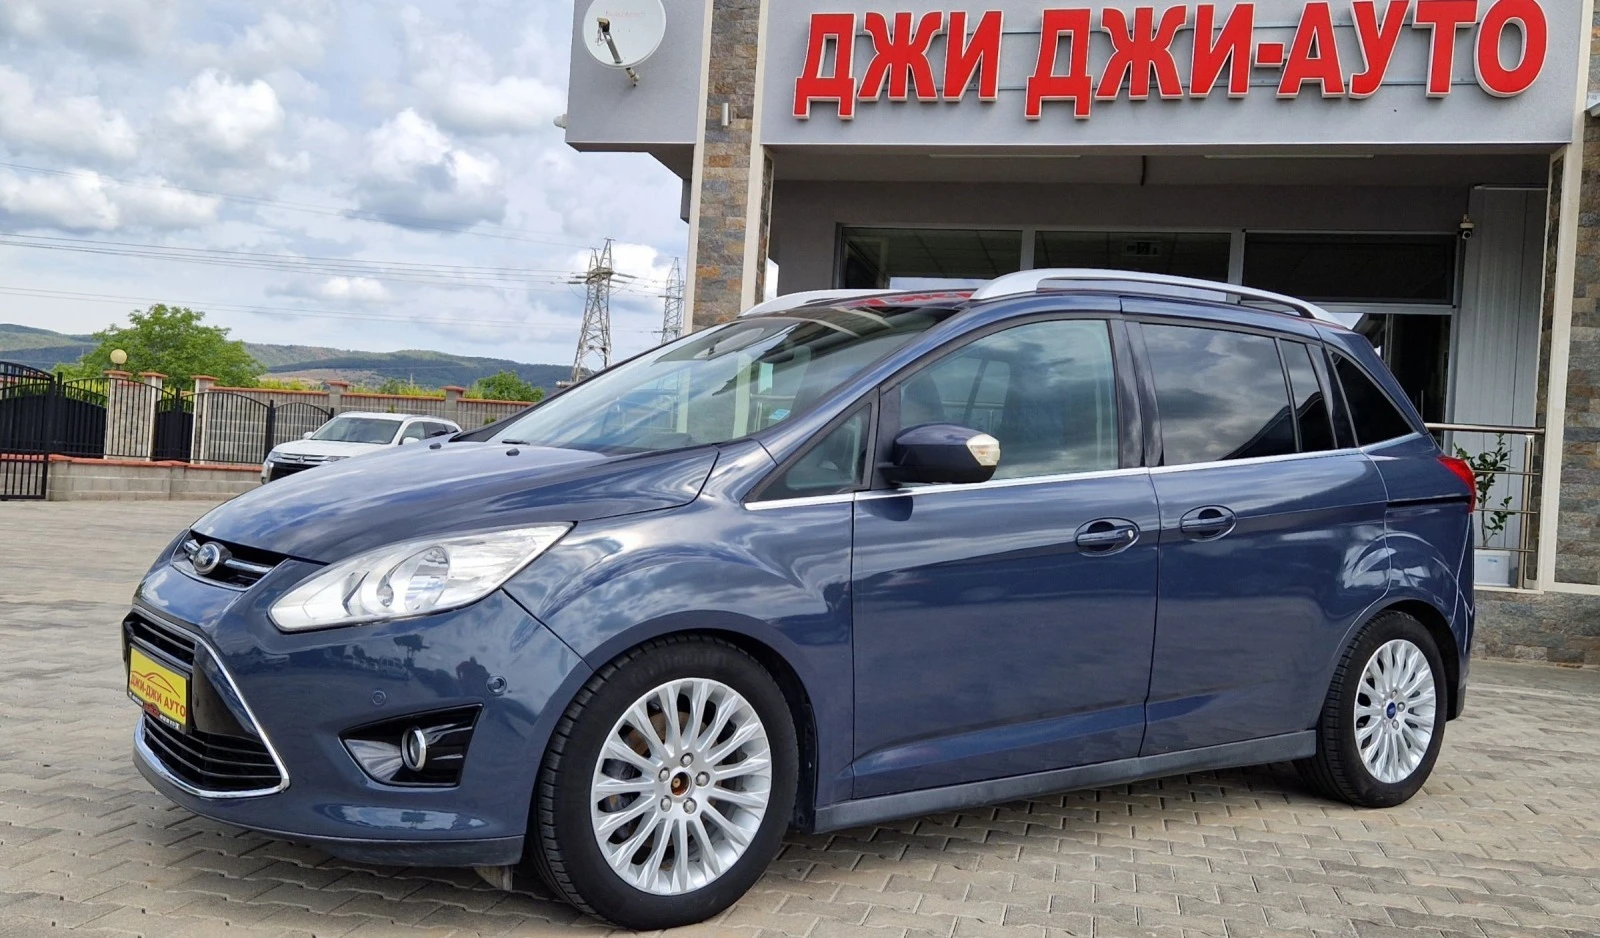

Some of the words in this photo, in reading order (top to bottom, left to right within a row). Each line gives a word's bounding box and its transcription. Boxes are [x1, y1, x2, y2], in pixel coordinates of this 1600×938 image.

[793, 10, 1004, 119] ДЖИ
[1024, 0, 1549, 120] ДЖИ-АУТО
[130, 673, 162, 704] ДЖИ-ДЖИ
[164, 696, 186, 717] АУТО
